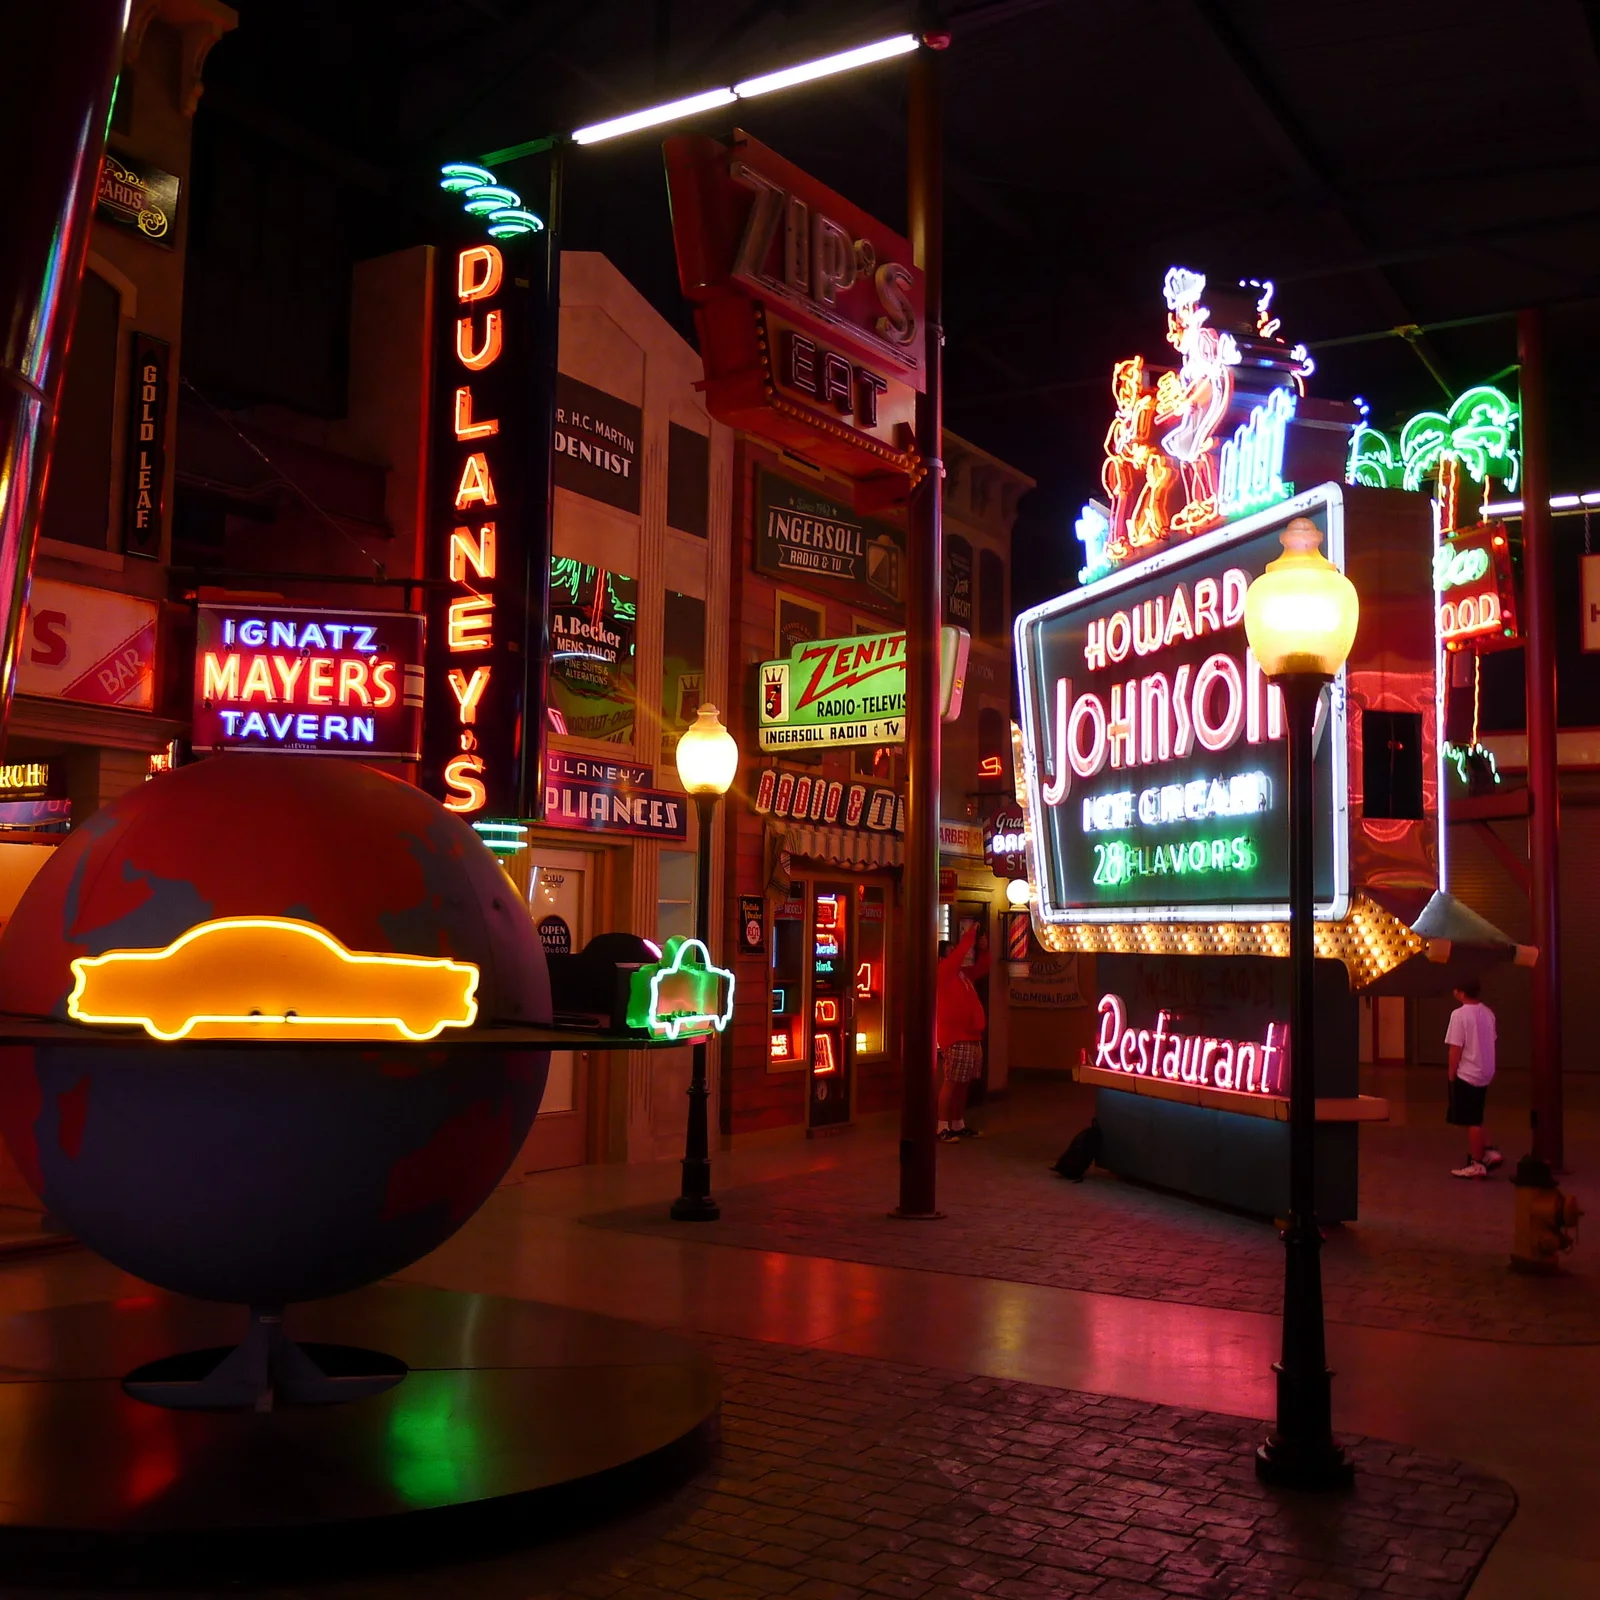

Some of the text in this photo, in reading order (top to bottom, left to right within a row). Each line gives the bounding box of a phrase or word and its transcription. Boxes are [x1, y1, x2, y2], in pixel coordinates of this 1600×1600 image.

[729, 161, 917, 347] ZIP'S
[139, 364, 158, 442] GOLD
[781, 331, 888, 428] EAT
[554, 430, 633, 478] DENTIST
[556, 408, 636, 455] R. H.C. MARTIN
[445, 244, 503, 812] DULANEY'S
[767, 511, 864, 557] INGERSOLL
[790, 550, 843, 571] RADIO & TV
[224, 619, 379, 652] IGNATZ
[552, 614, 622, 649] A. Becker
[1085, 567, 1250, 671] HOWARD
[97, 648, 146, 697] BAR
[556, 636, 617, 664] MENS TAILOR
[582, 661, 603, 675] SUITS
[603, 665, 609, 676] &
[796, 635, 908, 711] ZENIT
[203, 651, 397, 708] MAYER'S
[565, 668, 609, 686] ALTERATIONS
[219, 710, 376, 743] TAVERN
[765, 727, 825, 745] INGERSOLL
[829, 724, 868, 740] RADIO
[883, 720, 900, 736] TV
[757, 772, 844, 822] RADIO
[846, 787, 864, 825] &
[1082, 771, 1273, 833] ICE CREAM
[1093, 836, 1258, 886] 28 FLAVORS
[540, 924, 566, 936] OPEN
[540, 935, 568, 945] DAILY
[1095, 993, 1285, 1097] Restaurant
